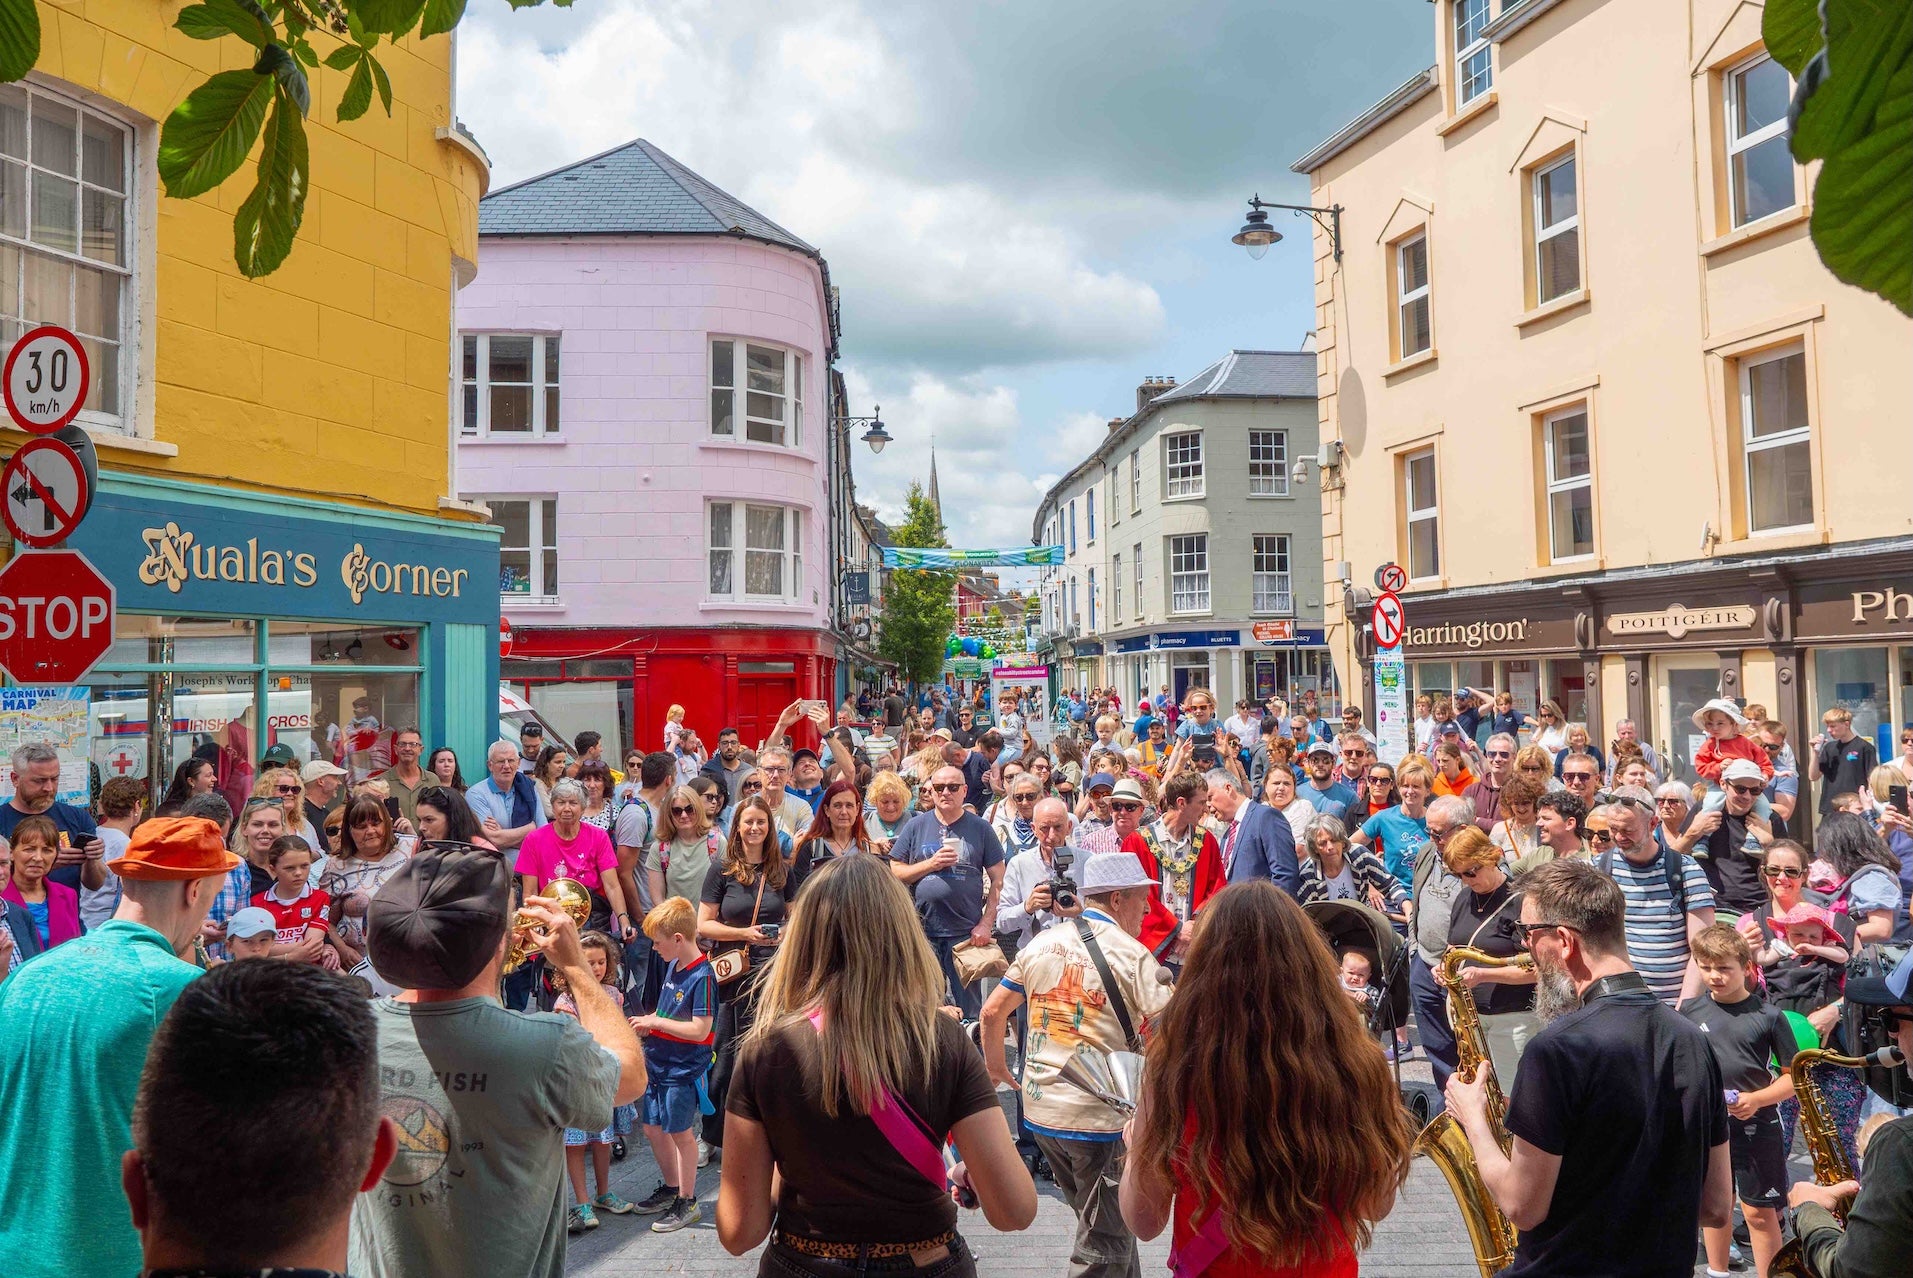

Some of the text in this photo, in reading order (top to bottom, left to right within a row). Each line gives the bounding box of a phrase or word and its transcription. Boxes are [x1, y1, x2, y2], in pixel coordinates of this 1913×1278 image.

[26, 349, 68, 393] 30
[29, 398, 60, 414] km/h
[138, 521, 468, 604] Nuala's Corner
[0, 596, 108, 640] STOP
[1620, 611, 1741, 629] POITIGÉIR
[1160, 637, 1187, 645] pharmacy
[179, 675, 223, 688] Joseph's
[3, 689, 57, 699] CARNIVAL
[3, 698, 37, 711] MAP
[189, 718, 228, 732] IRISH
[428, 1070, 488, 1093] FISH
[460, 1142, 484, 1153] 1993
